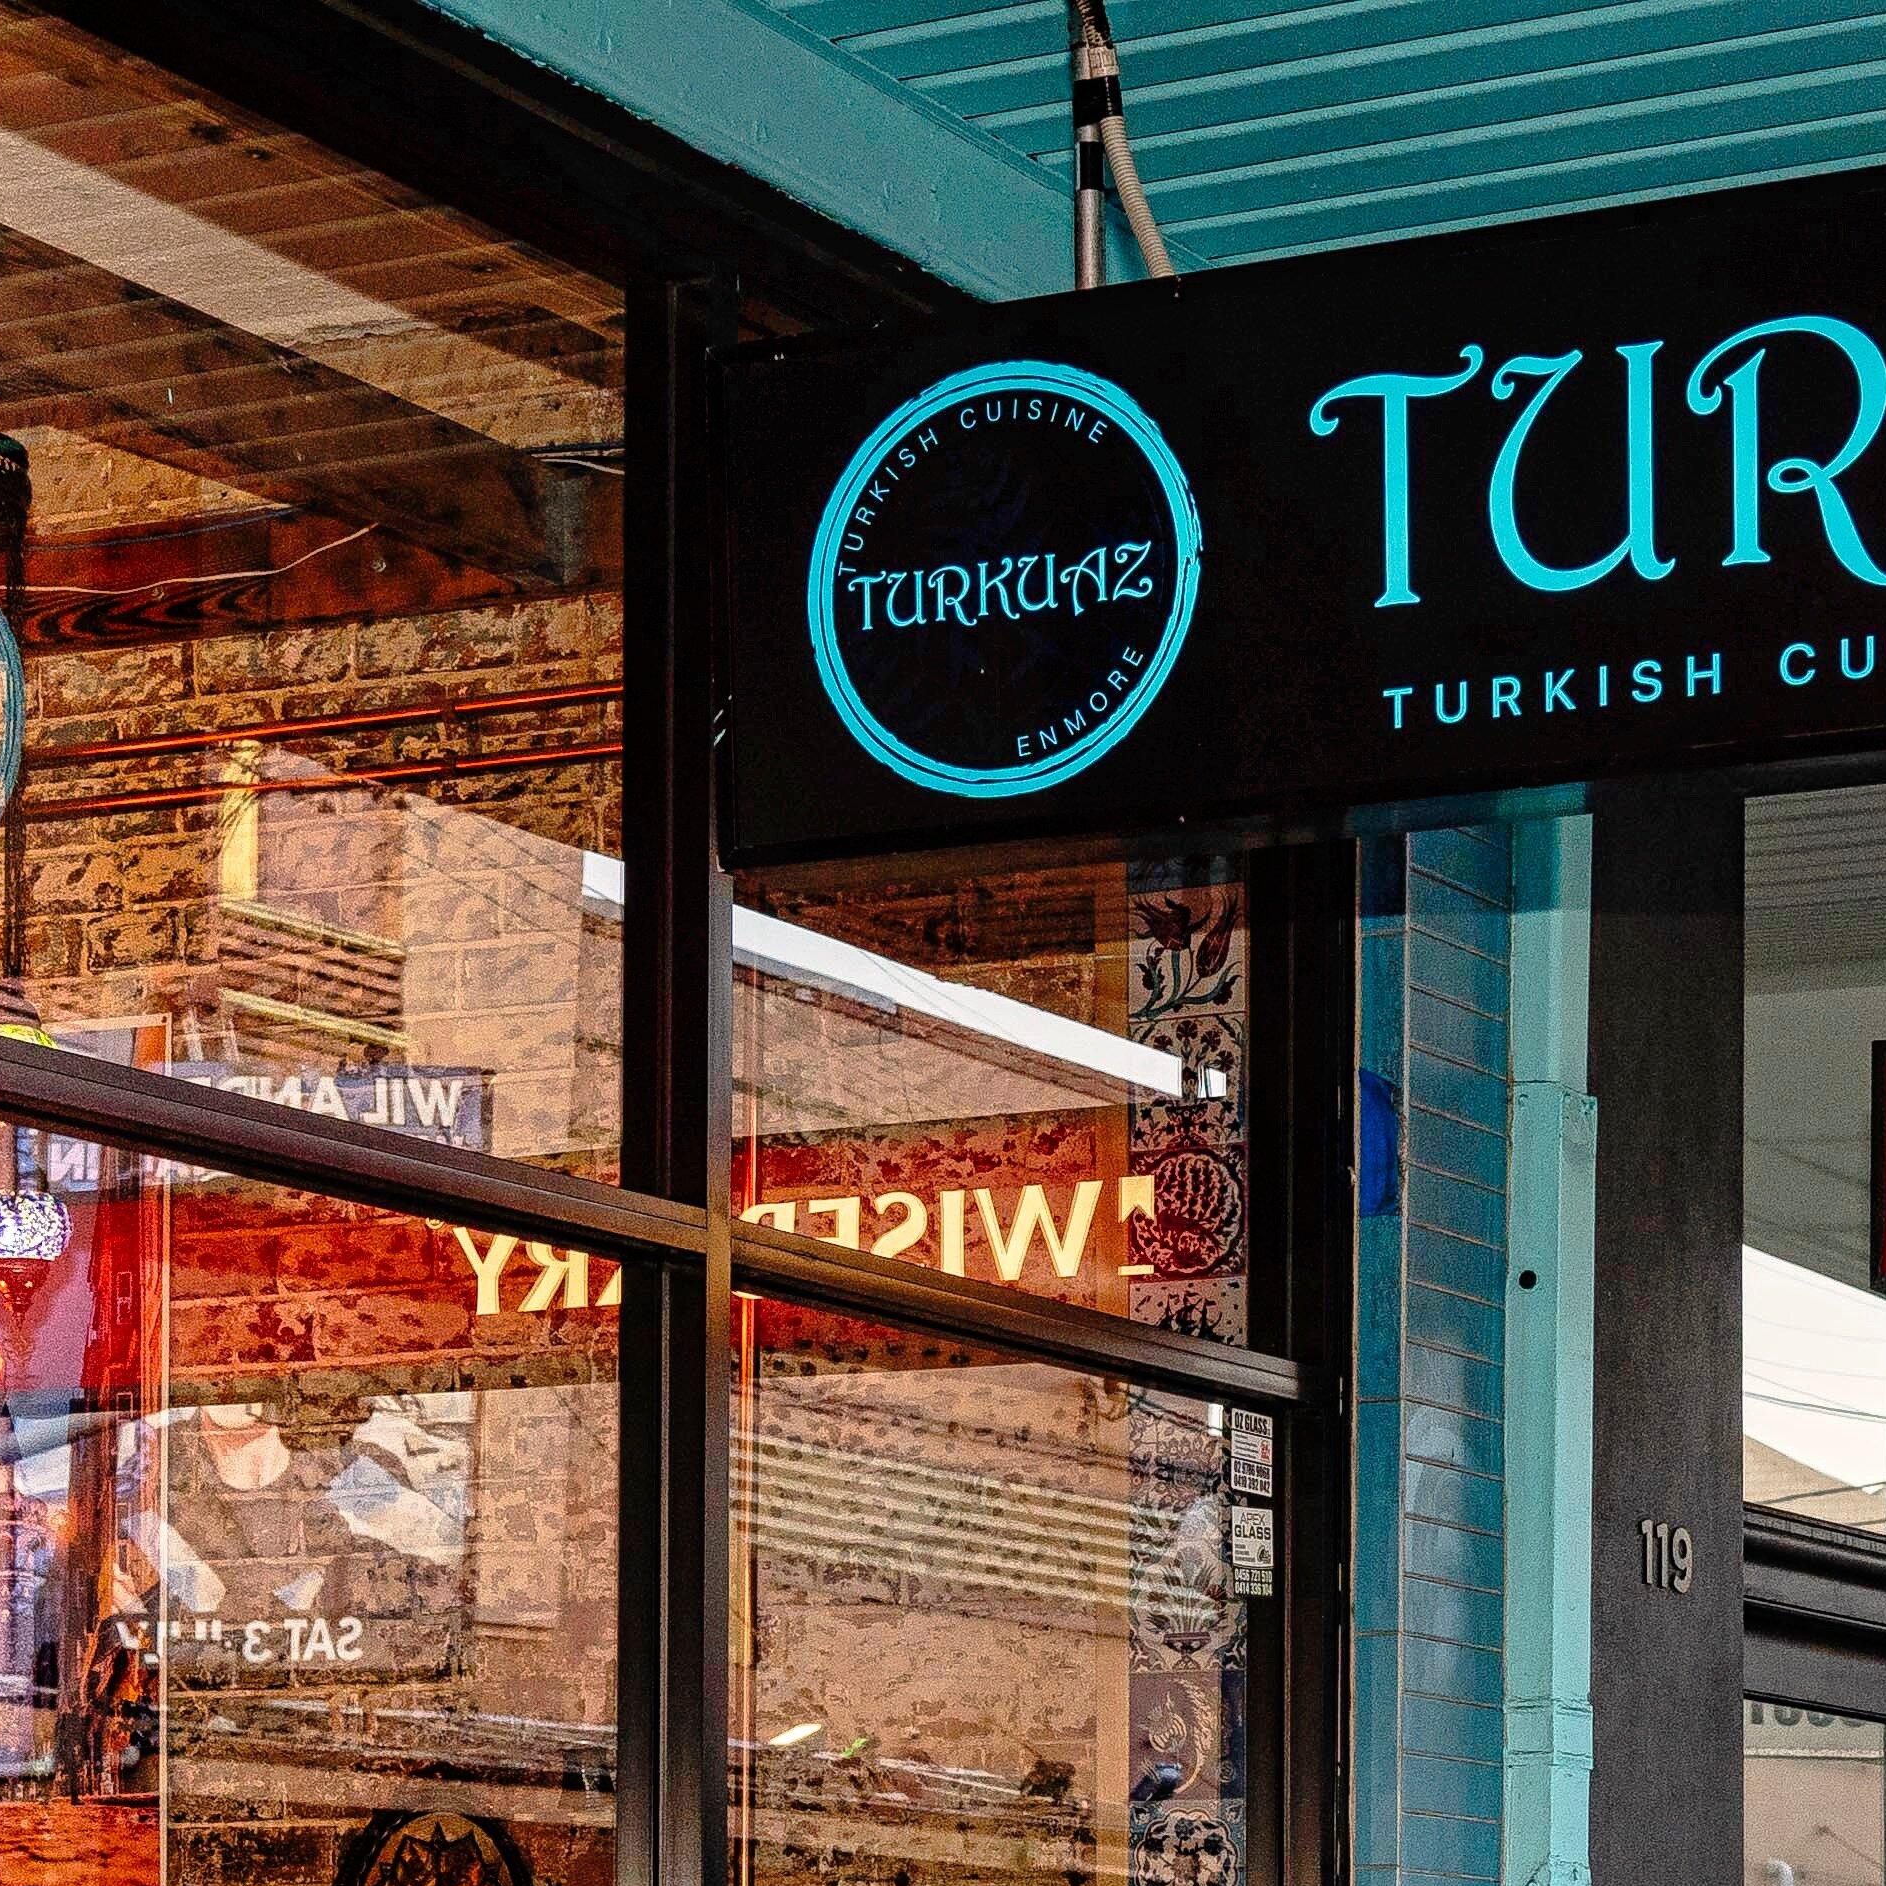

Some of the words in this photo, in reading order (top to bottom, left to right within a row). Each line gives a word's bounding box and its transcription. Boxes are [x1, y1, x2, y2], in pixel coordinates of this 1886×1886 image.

[837, 428, 939, 577] TURKISH
[960, 398, 1108, 444] CUISINE
[847, 540, 1153, 631] TURKUAZ
[1017, 646, 1144, 757] ENMORE
[1381, 650, 1724, 730] TURKISH
[1234, 1526, 1271, 1541] GLASS
[1639, 1518, 1694, 1593] 119
